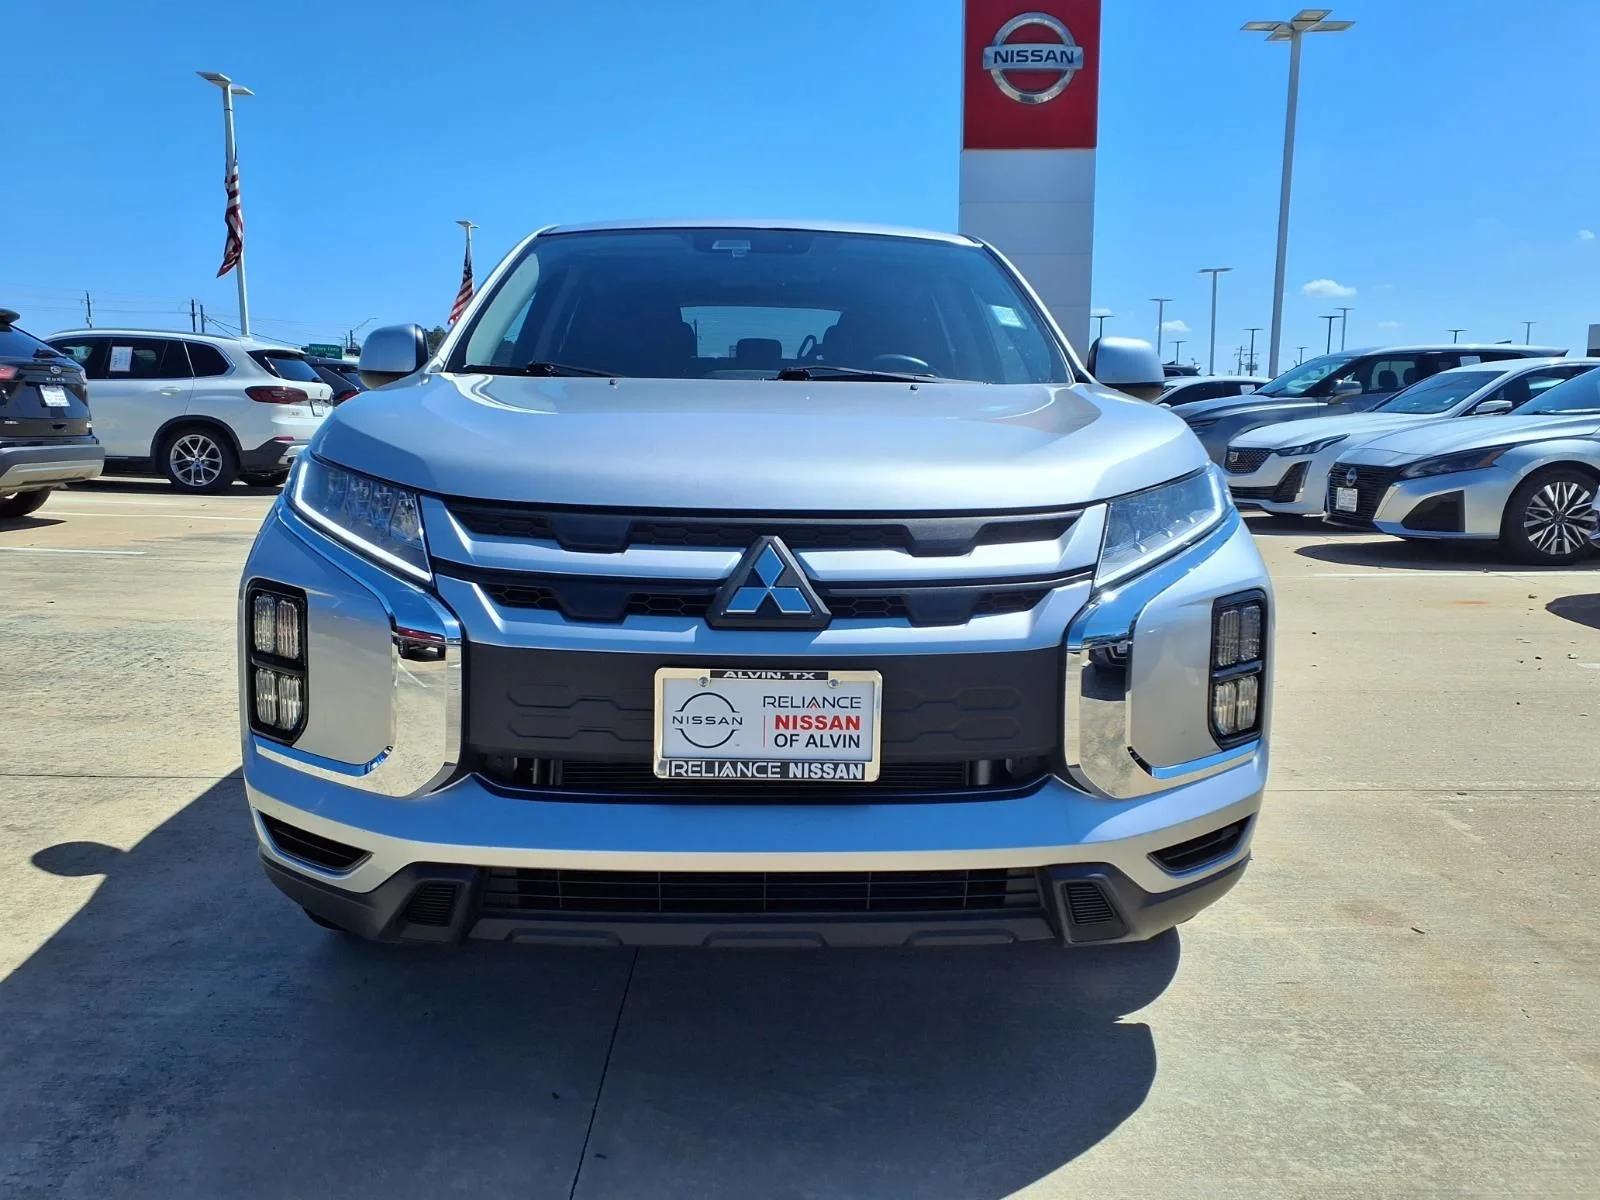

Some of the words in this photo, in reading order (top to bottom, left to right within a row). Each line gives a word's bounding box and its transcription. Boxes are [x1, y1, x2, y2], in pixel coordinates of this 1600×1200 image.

[993, 50, 1074, 64] NISSAN
[789, 672, 816, 680] TX
[763, 696, 861, 710] RELIANCE
[672, 716, 743, 726] NISSAN
[775, 715, 860, 731] NISSAN
[774, 733, 800, 747] OF
[805, 734, 860, 749] ALVIN
[671, 761, 781, 778] RELIANCE
[789, 763, 863, 780] NISSAN
